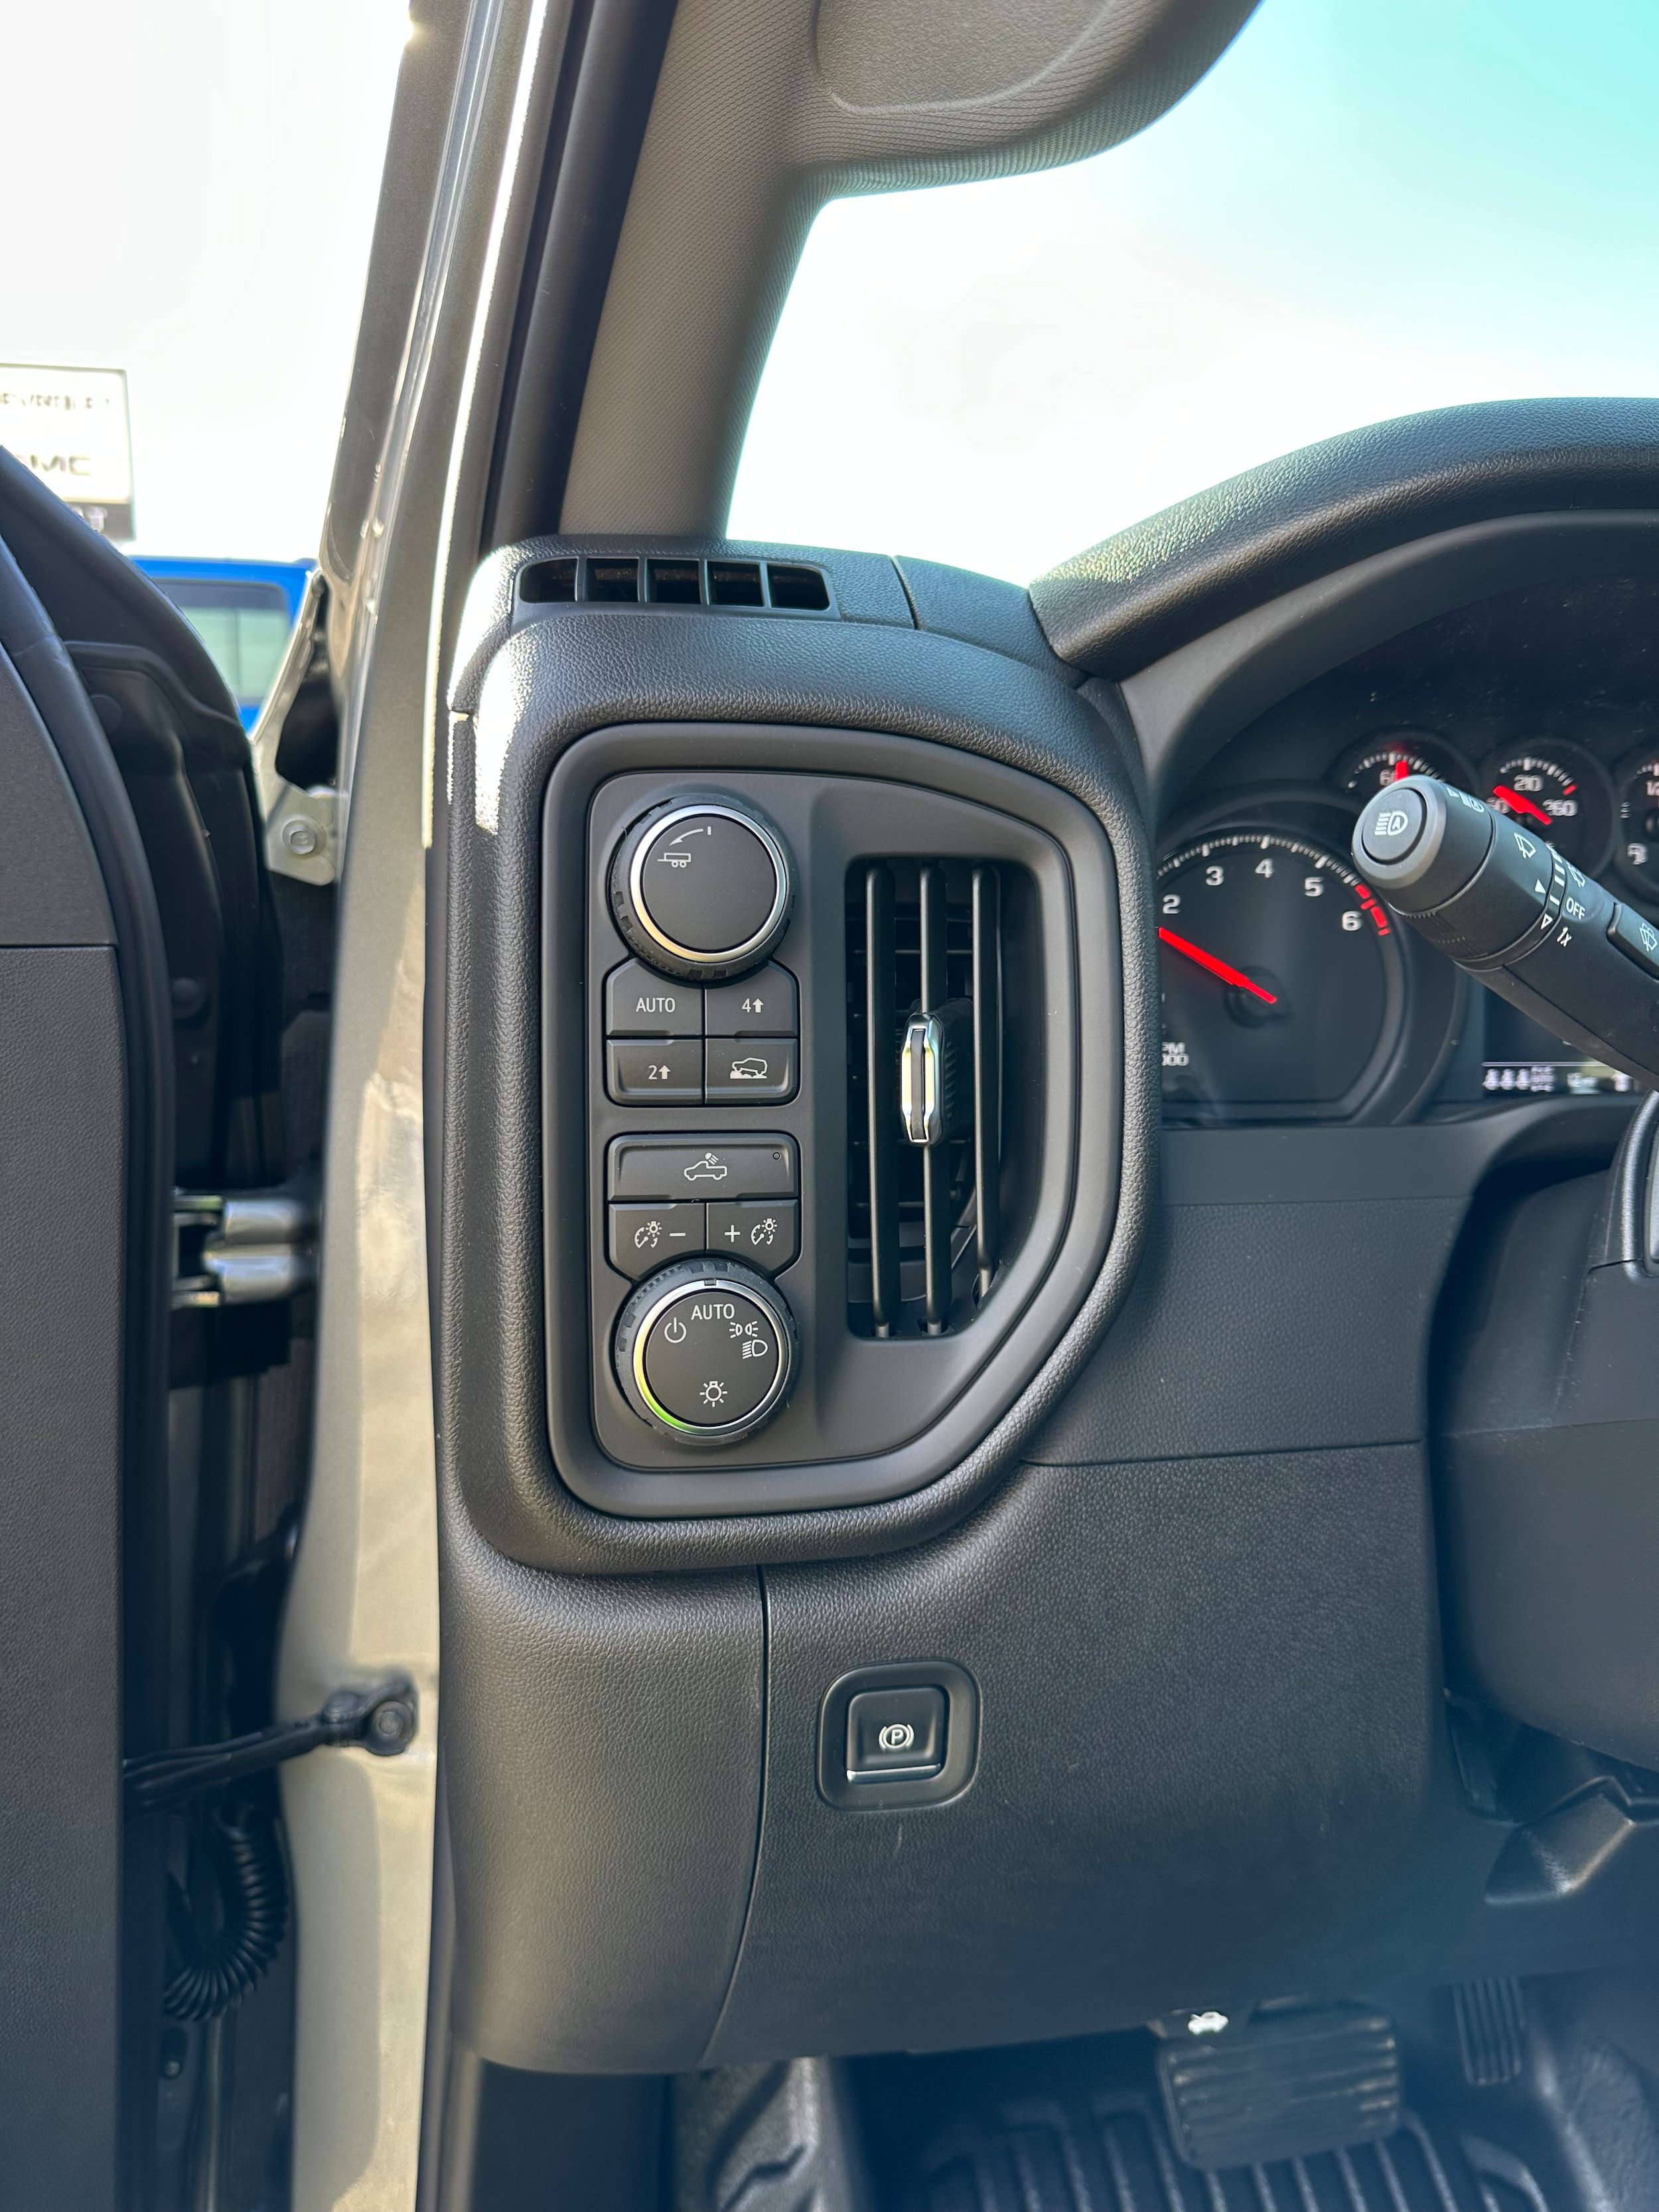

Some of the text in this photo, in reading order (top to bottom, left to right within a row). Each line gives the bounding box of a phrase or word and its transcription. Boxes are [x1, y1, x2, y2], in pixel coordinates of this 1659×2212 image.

[1205, 865, 1224, 886] 3
[1255, 858, 1273, 878] 4
[1304, 877, 1325, 897] 5
[1162, 894, 1181, 914] 2
[1565, 897, 1585, 921] OFF
[1341, 911, 1362, 931] 6
[1556, 926, 1572, 947] 1x
[636, 997, 676, 1013] AUTO
[742, 998, 751, 1013] 4
[648, 1065, 657, 1080] 2
[691, 1303, 735, 1320] AUTO
